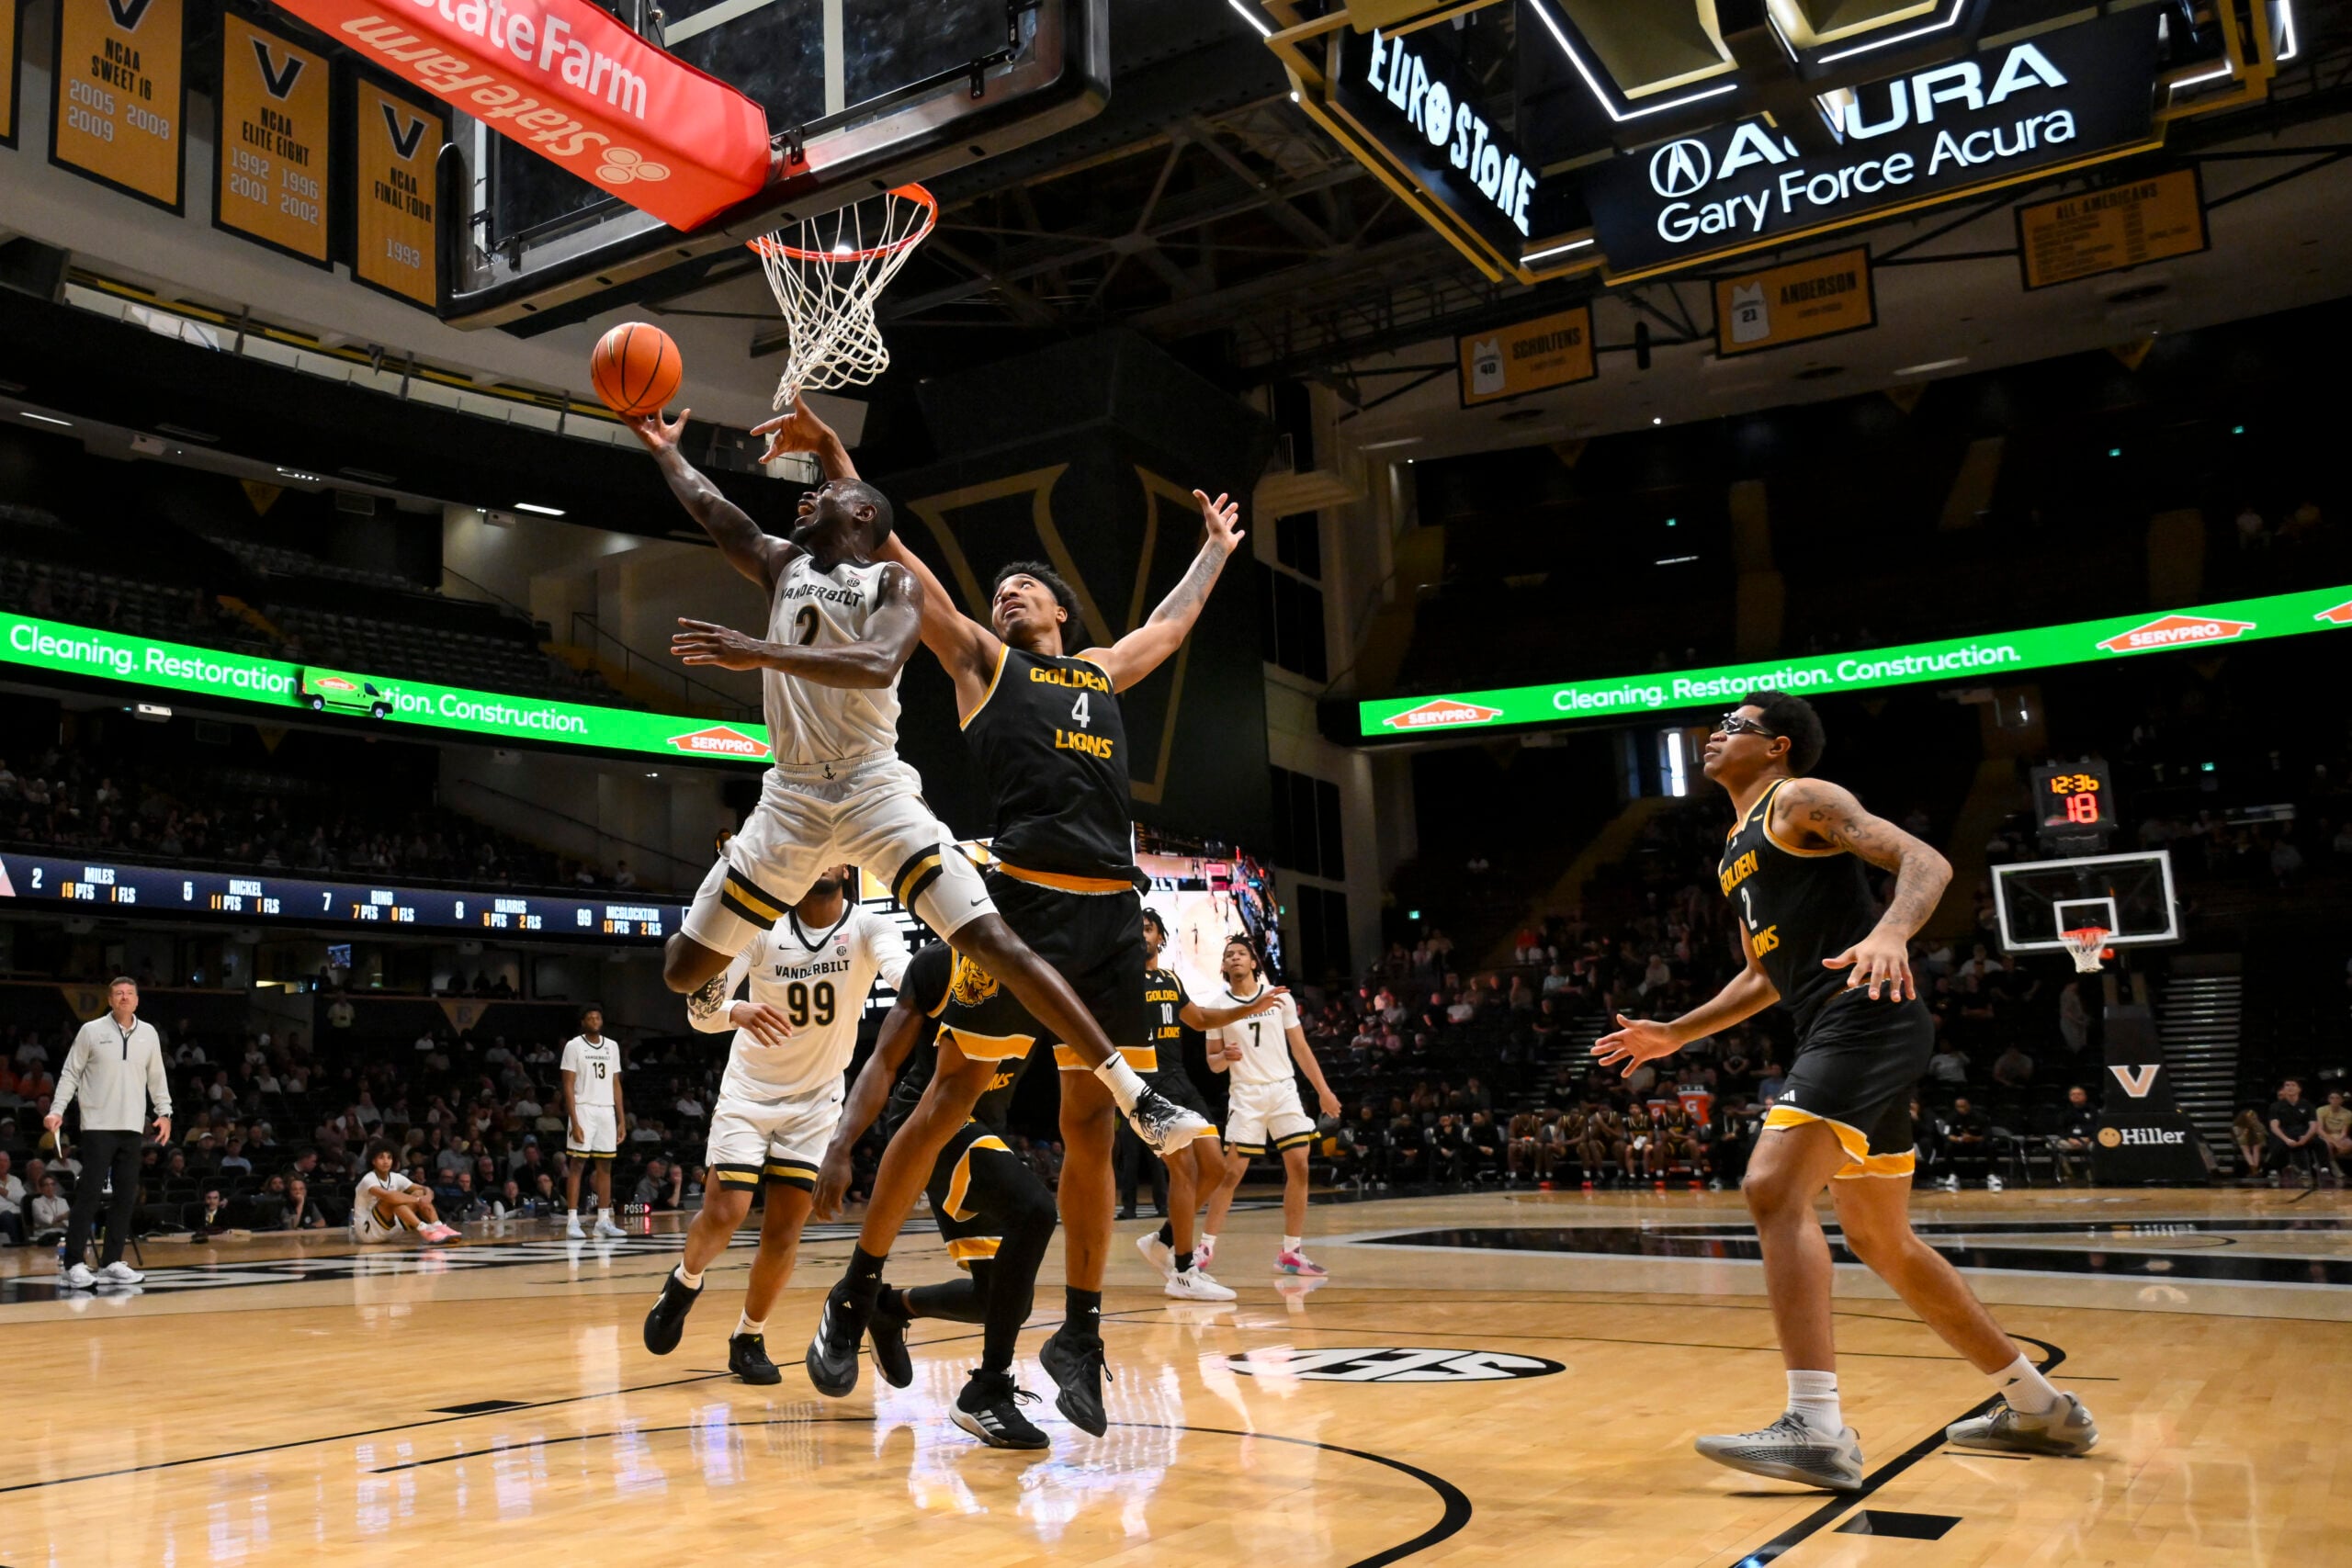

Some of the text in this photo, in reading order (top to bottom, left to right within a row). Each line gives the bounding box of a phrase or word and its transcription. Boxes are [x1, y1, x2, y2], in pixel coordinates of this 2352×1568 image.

[105, 38, 141, 73] NCAA
[92, 55, 153, 101] SWEET 16
[69, 78, 170, 141] 2005 2008
[261, 107, 292, 138] NCAA
[1716, 43, 2069, 181] AURA
[67, 105, 114, 143] 2009
[242, 121, 311, 167] ELITE EIGHT
[232, 147, 319, 200] 1992 1996
[390, 167, 418, 197] NCAA
[1657, 109, 2076, 243] Gary Force Acura
[230, 173, 319, 226] 2001 2002
[375, 180, 432, 223] FINAL FOUR
[386, 238, 421, 269] 1993
[1781, 271, 1857, 306] ANDERSON
[10, 624, 139, 674] Cleaning.
[1030, 667, 1109, 694] GOLDEN
[1553, 644, 2021, 711] Cleaning. Restoration. Construction.
[439, 693, 588, 734] Construction.
[1071, 692, 1091, 728] 4
[1056, 729, 1114, 759] LIONS
[2050, 773, 2099, 795] 12:36
[2066, 793, 2098, 824] 18
[31, 868, 42, 888] 2
[84, 866, 115, 885] MILES
[1721, 850, 1758, 897] GOLDEN
[62, 882, 136, 904] 15 PTS 1 FLS
[183, 881, 193, 901] 5
[229, 879, 263, 897] NICKEL
[322, 892, 332, 911] 7
[370, 890, 393, 906] BING
[210, 895, 279, 914] 11 PTS 1 FLS
[353, 904, 359, 919] 7
[360, 905, 379, 920] PTS
[399, 907, 414, 922] FLS
[494, 898, 526, 914] HARRIS
[577, 908, 592, 927] 99
[605, 905, 659, 922] MCGLOCKTON
[1740, 886, 1758, 931] 2
[483, 912, 542, 930] 5 PTS 2 FLS
[604, 919, 662, 937] 13 PTS 2 FLS
[775, 959, 850, 977] VANDERBILT
[787, 981, 835, 1027] 99
[1146, 989, 1180, 1002] GOLDEN
[1160, 1002, 1173, 1025] 10
[1158, 1026, 1181, 1039] LIONS
[1249, 1021, 1261, 1047] 7
[593, 1062, 605, 1079] 13
[2120, 1127, 2186, 1145] Hiller
[625, 1204, 644, 1214] POSS
